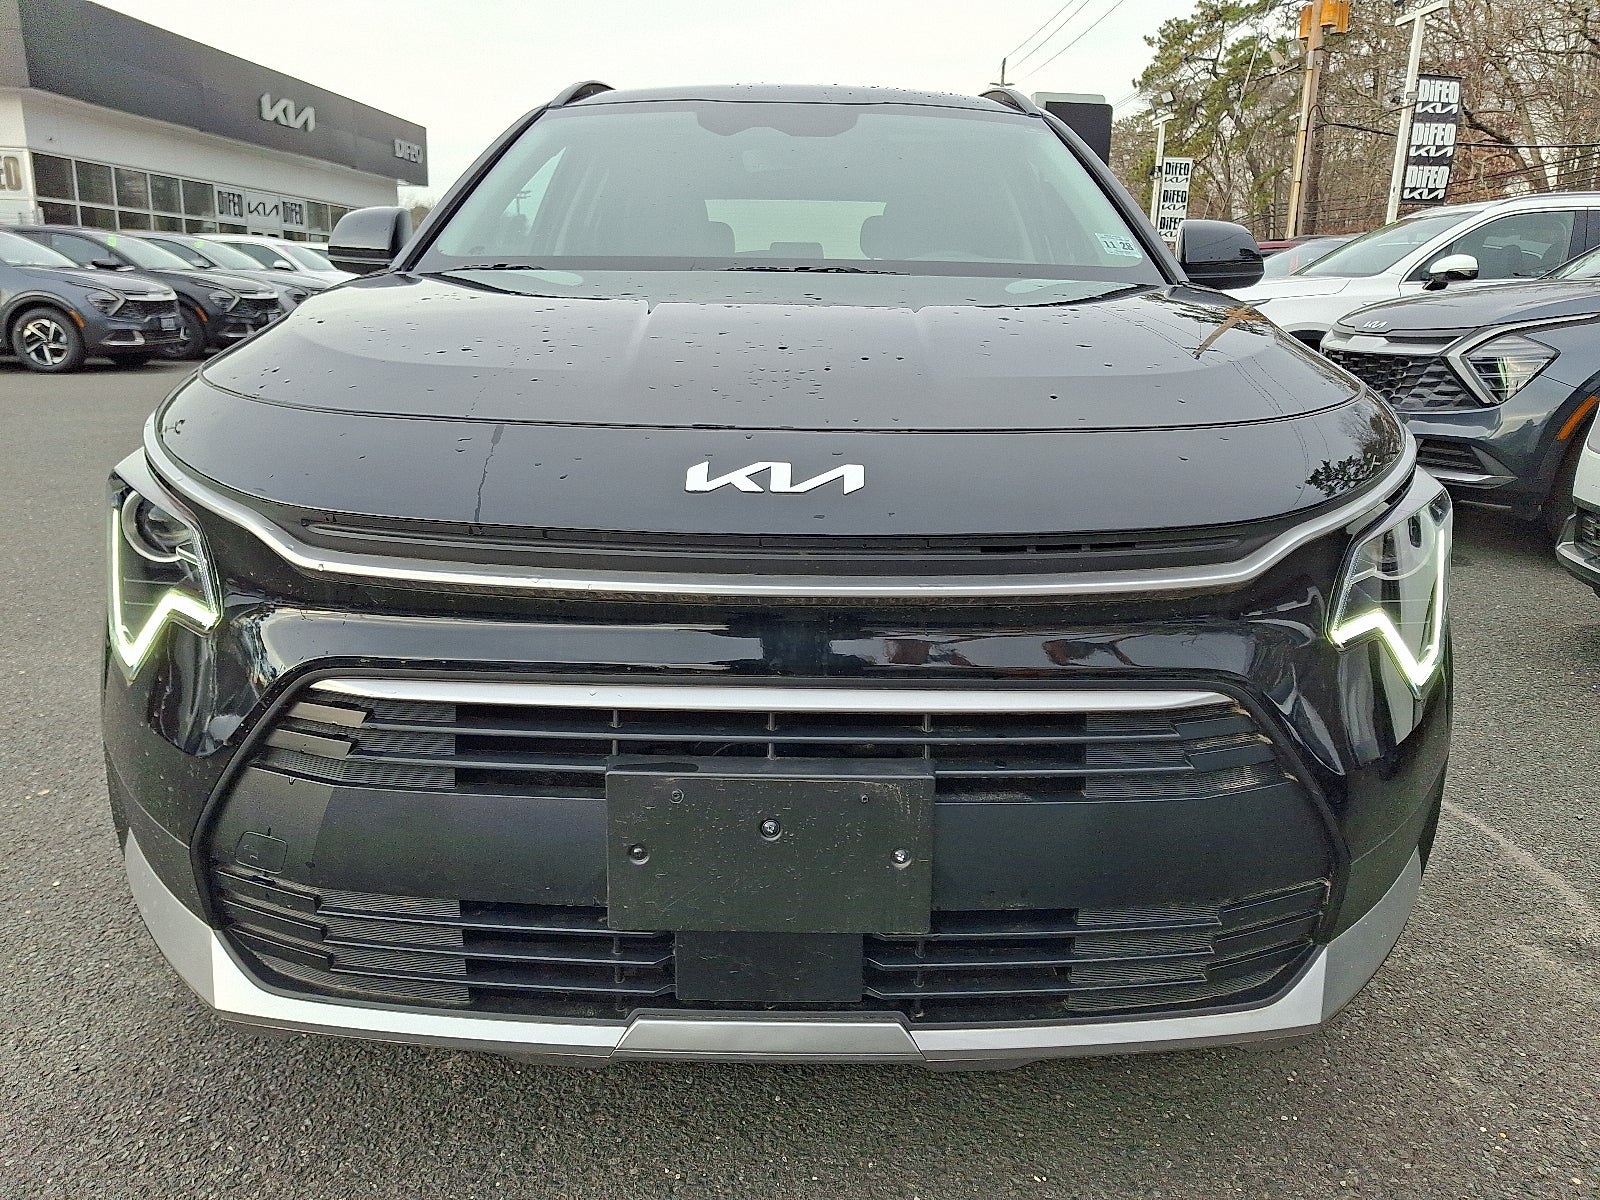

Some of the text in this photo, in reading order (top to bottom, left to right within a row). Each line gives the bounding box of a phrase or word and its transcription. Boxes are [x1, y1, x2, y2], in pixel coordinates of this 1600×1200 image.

[1417, 79, 1460, 104] DiFEO
[260, 92, 316, 132] KIA
[1415, 102, 1459, 114] KIA
[1410, 123, 1457, 146] DiFEO
[1409, 145, 1454, 157] KIA
[1164, 161, 1190, 176] DiFEO
[1404, 165, 1450, 189] DiFEO
[1162, 189, 1187, 203] DiFEO
[1402, 188, 1446, 200] KIA
[248, 201, 279, 217] KIA
[1158, 230, 1177, 238] KI
[1103, 240, 1117, 249] 11
[684, 461, 866, 496] KIA
